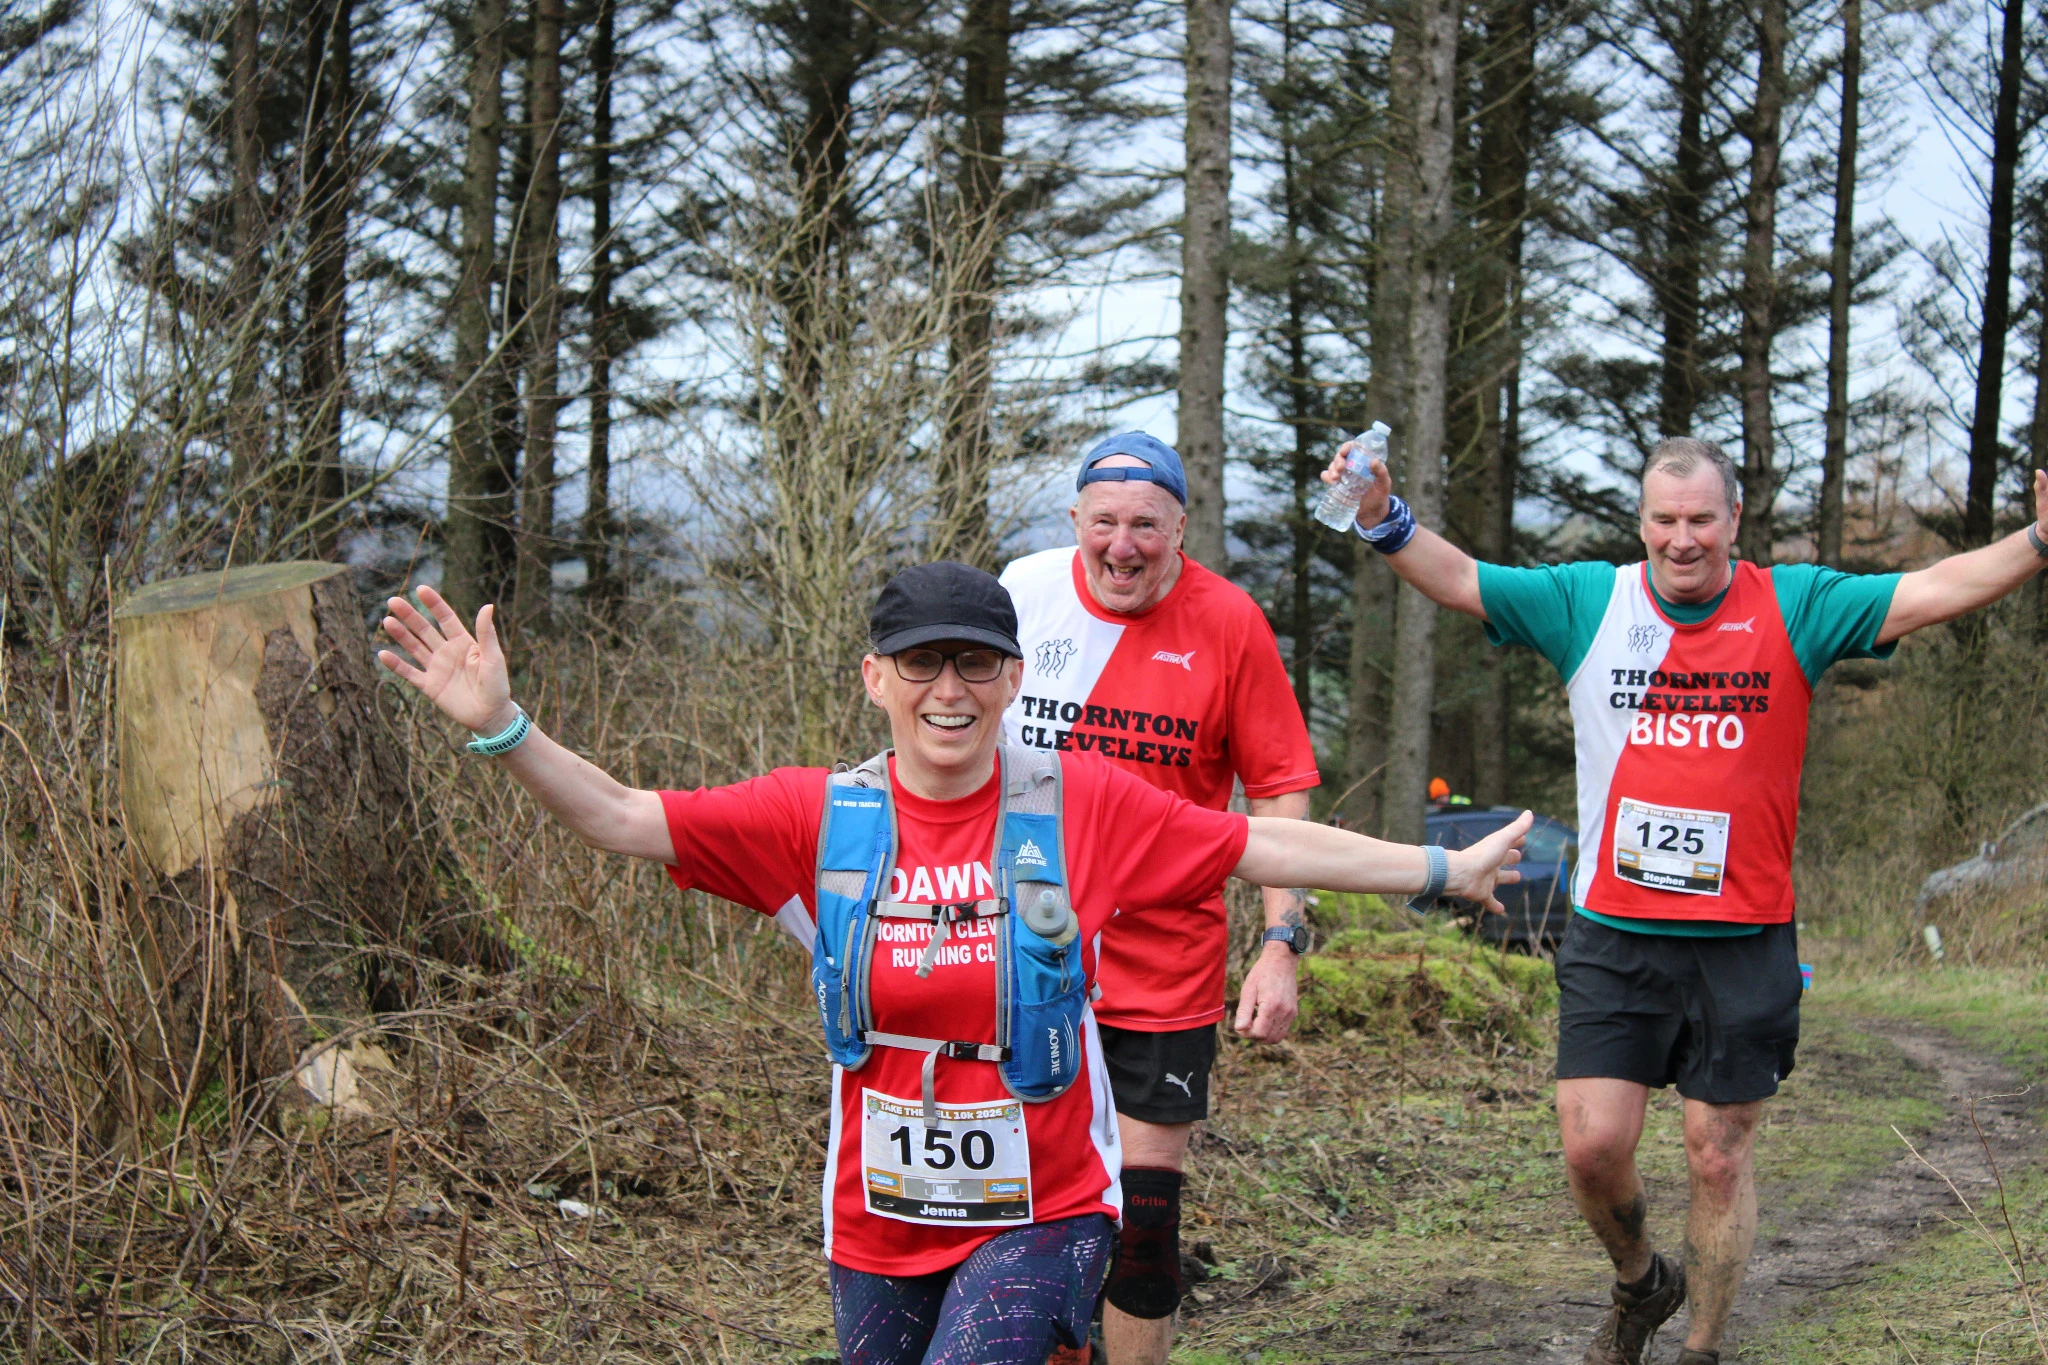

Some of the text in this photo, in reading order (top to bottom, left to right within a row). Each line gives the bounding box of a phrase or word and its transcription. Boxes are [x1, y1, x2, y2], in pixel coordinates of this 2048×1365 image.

[1611, 669, 1771, 689] THORNTON
[1610, 692, 1769, 713] CLEVELEYS
[1022, 695, 1198, 741] THORNTON
[1630, 713, 1745, 749] BISTO
[1022, 725, 1192, 767] CLEVELEYS
[1636, 821, 1704, 855] 125
[1642, 872, 1686, 887] Stephen
[1047, 1027, 1061, 1077] AONIJIE
[879, 1101, 902, 1115] TAKE
[904, 1107, 924, 1117] THE
[953, 1111, 974, 1120] 10k
[889, 1125, 995, 1170] 150
[919, 1204, 968, 1218] Jenna
[1131, 1195, 1168, 1207] Gritin
